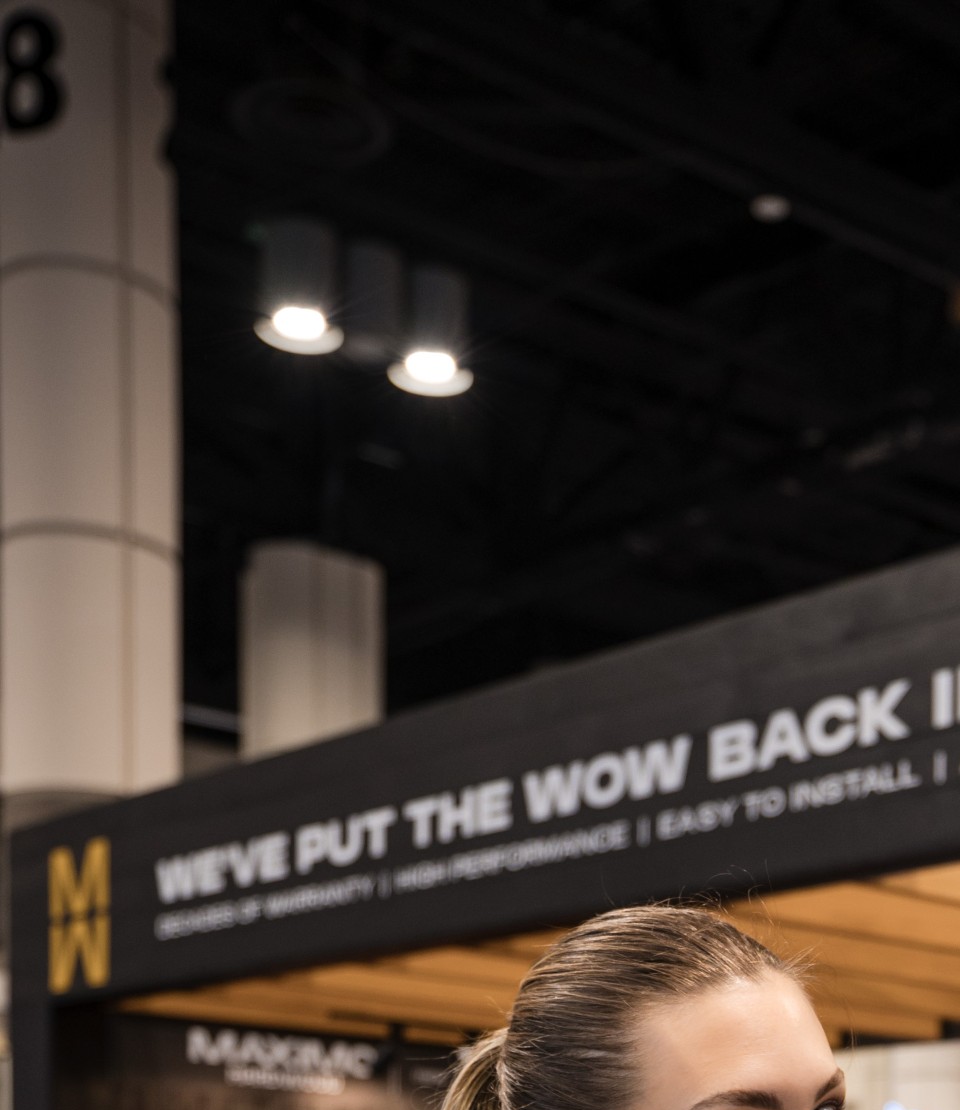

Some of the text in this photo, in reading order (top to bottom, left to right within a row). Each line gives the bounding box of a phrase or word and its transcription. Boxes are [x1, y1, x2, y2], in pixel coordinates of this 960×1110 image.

[2, 5, 68, 138] 8
[154, 830, 290, 904] WE'VE
[296, 805, 397, 876] PUT
[402, 779, 513, 849] THE
[521, 733, 693, 824] WOW
[708, 679, 911, 782] BACK
[450, 817, 632, 881] PERFORMANCE
[656, 800, 738, 842] EASY
[741, 786, 787, 821] TO
[789, 758, 922, 812] INSTALL
